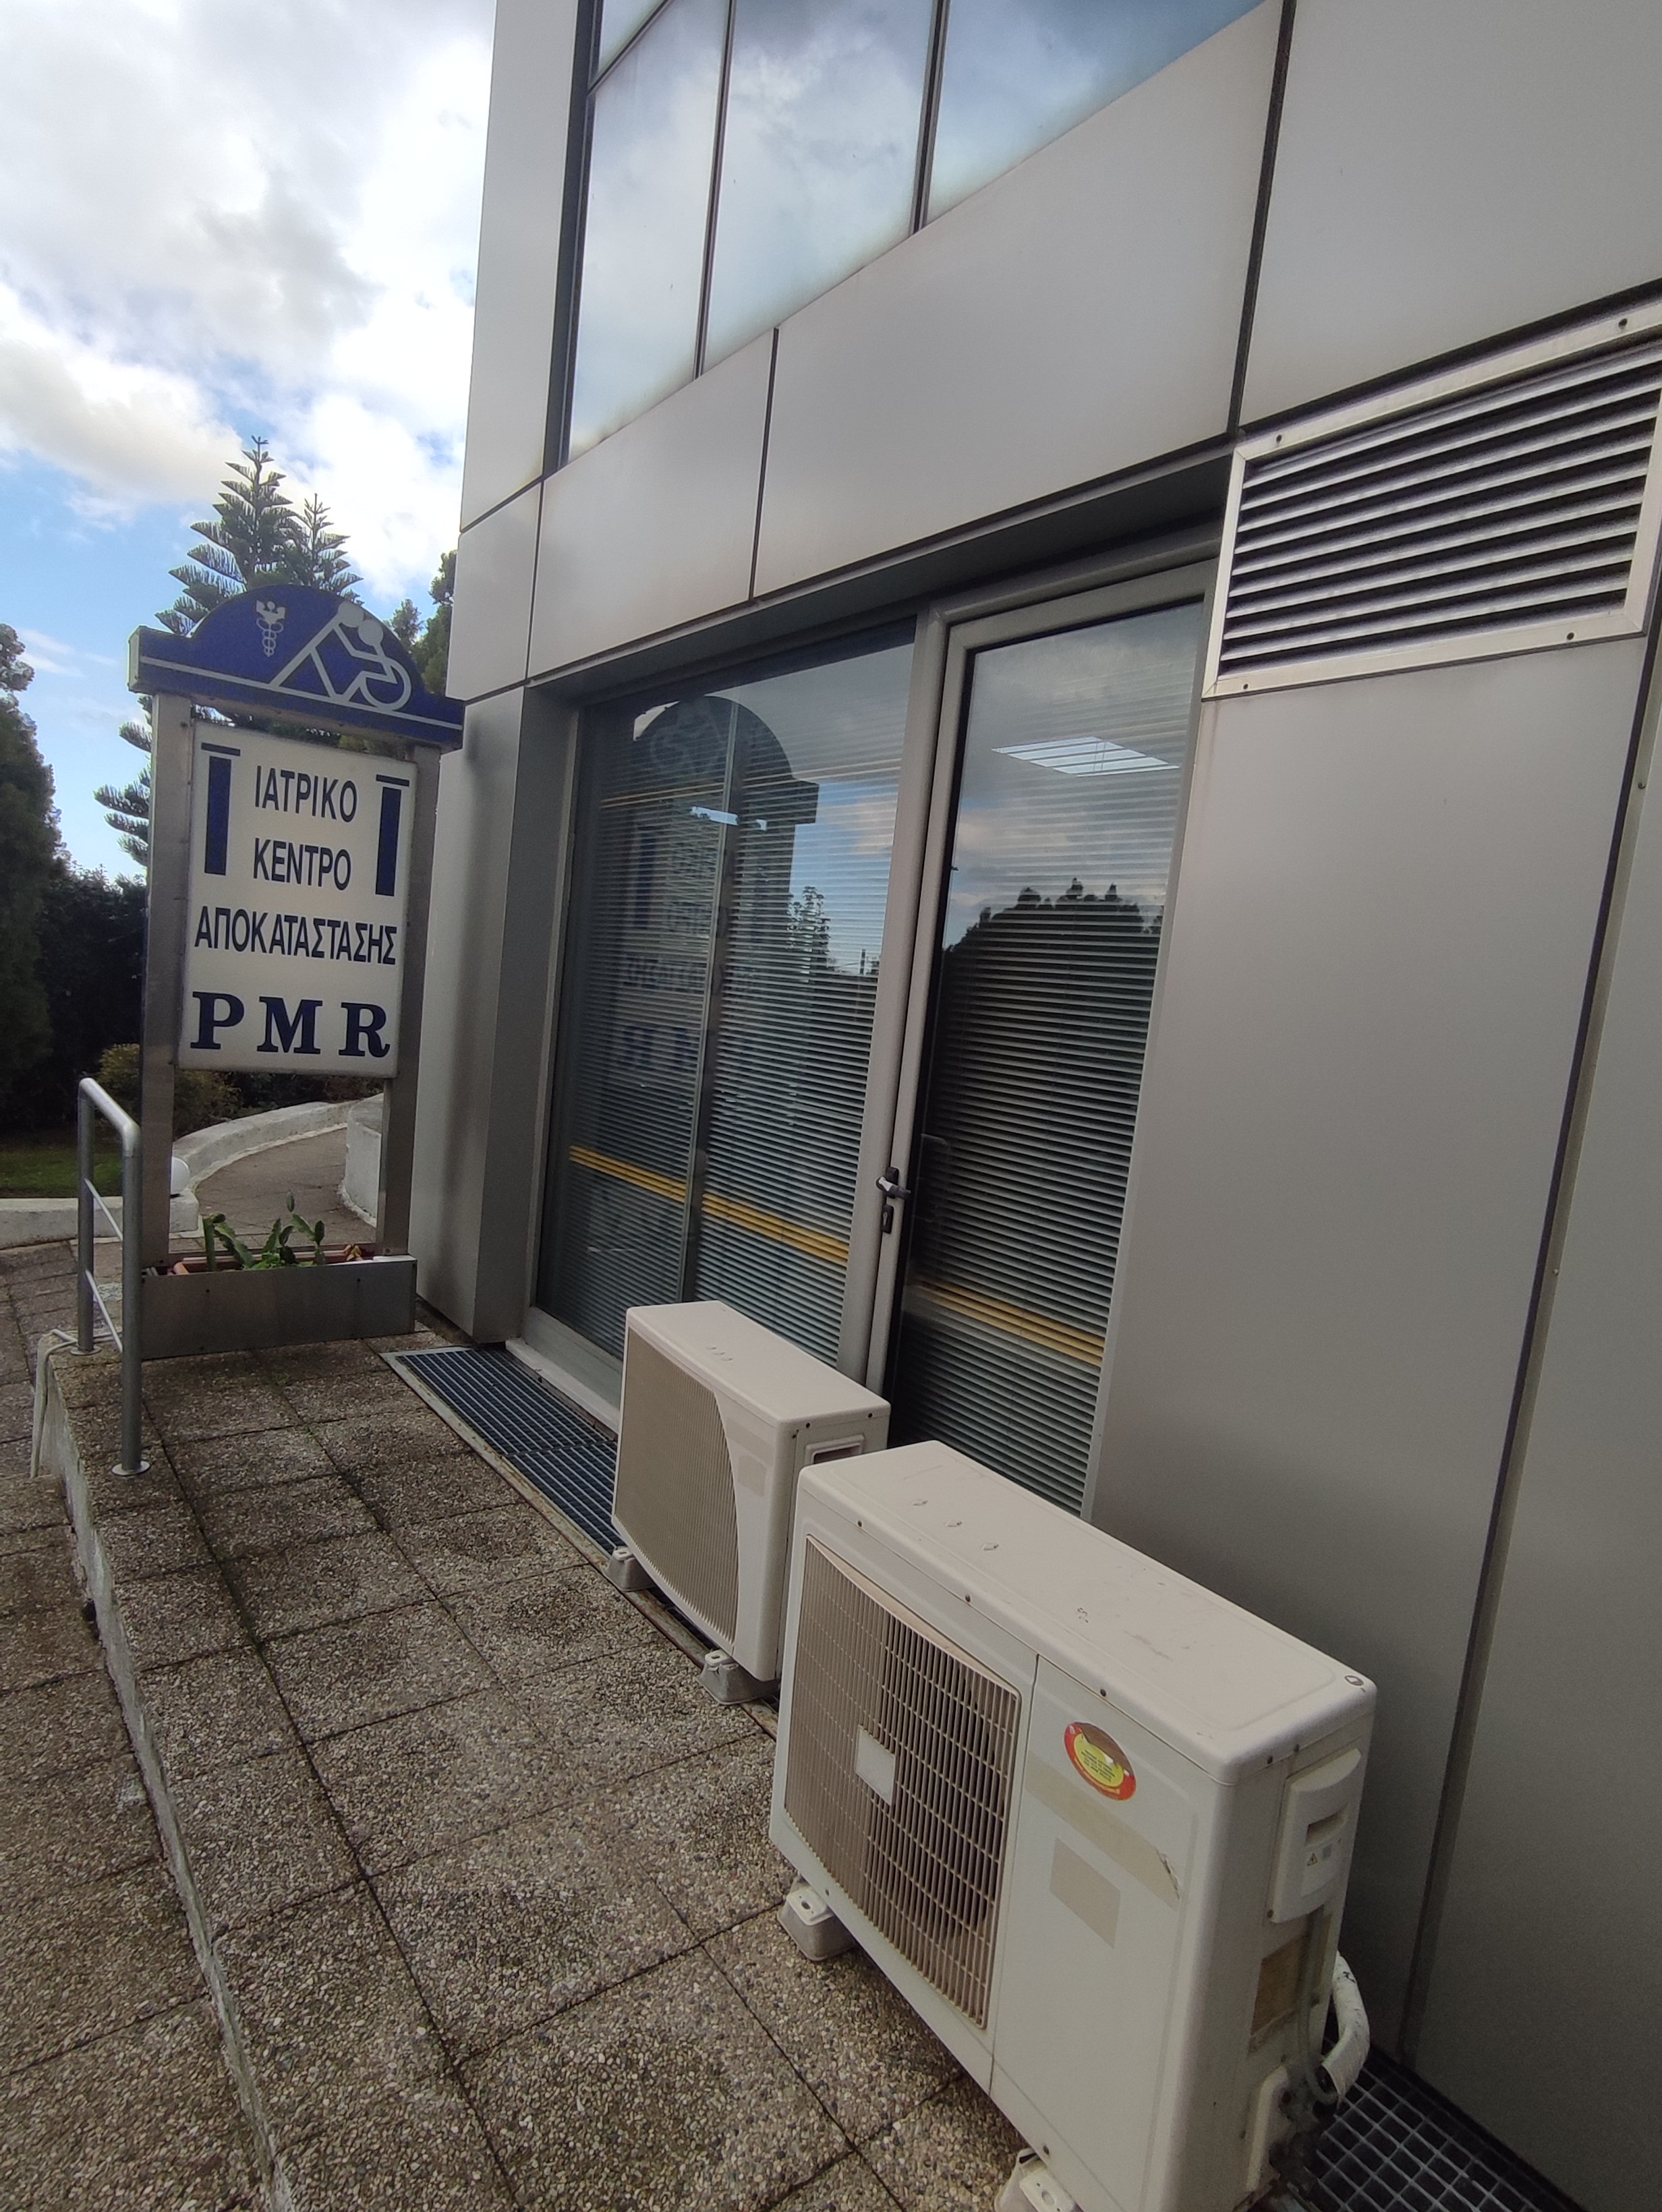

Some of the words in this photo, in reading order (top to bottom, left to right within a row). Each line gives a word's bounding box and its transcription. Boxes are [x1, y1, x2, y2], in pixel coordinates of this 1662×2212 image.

[254, 765, 357, 823] ΙΑΤΡΙΚΟ
[253, 838, 351, 891] ΚΕΝΤΡΟ
[194, 906, 397, 966] ΑΠΟΚΑΤΑΣΤΑΣΗΣ
